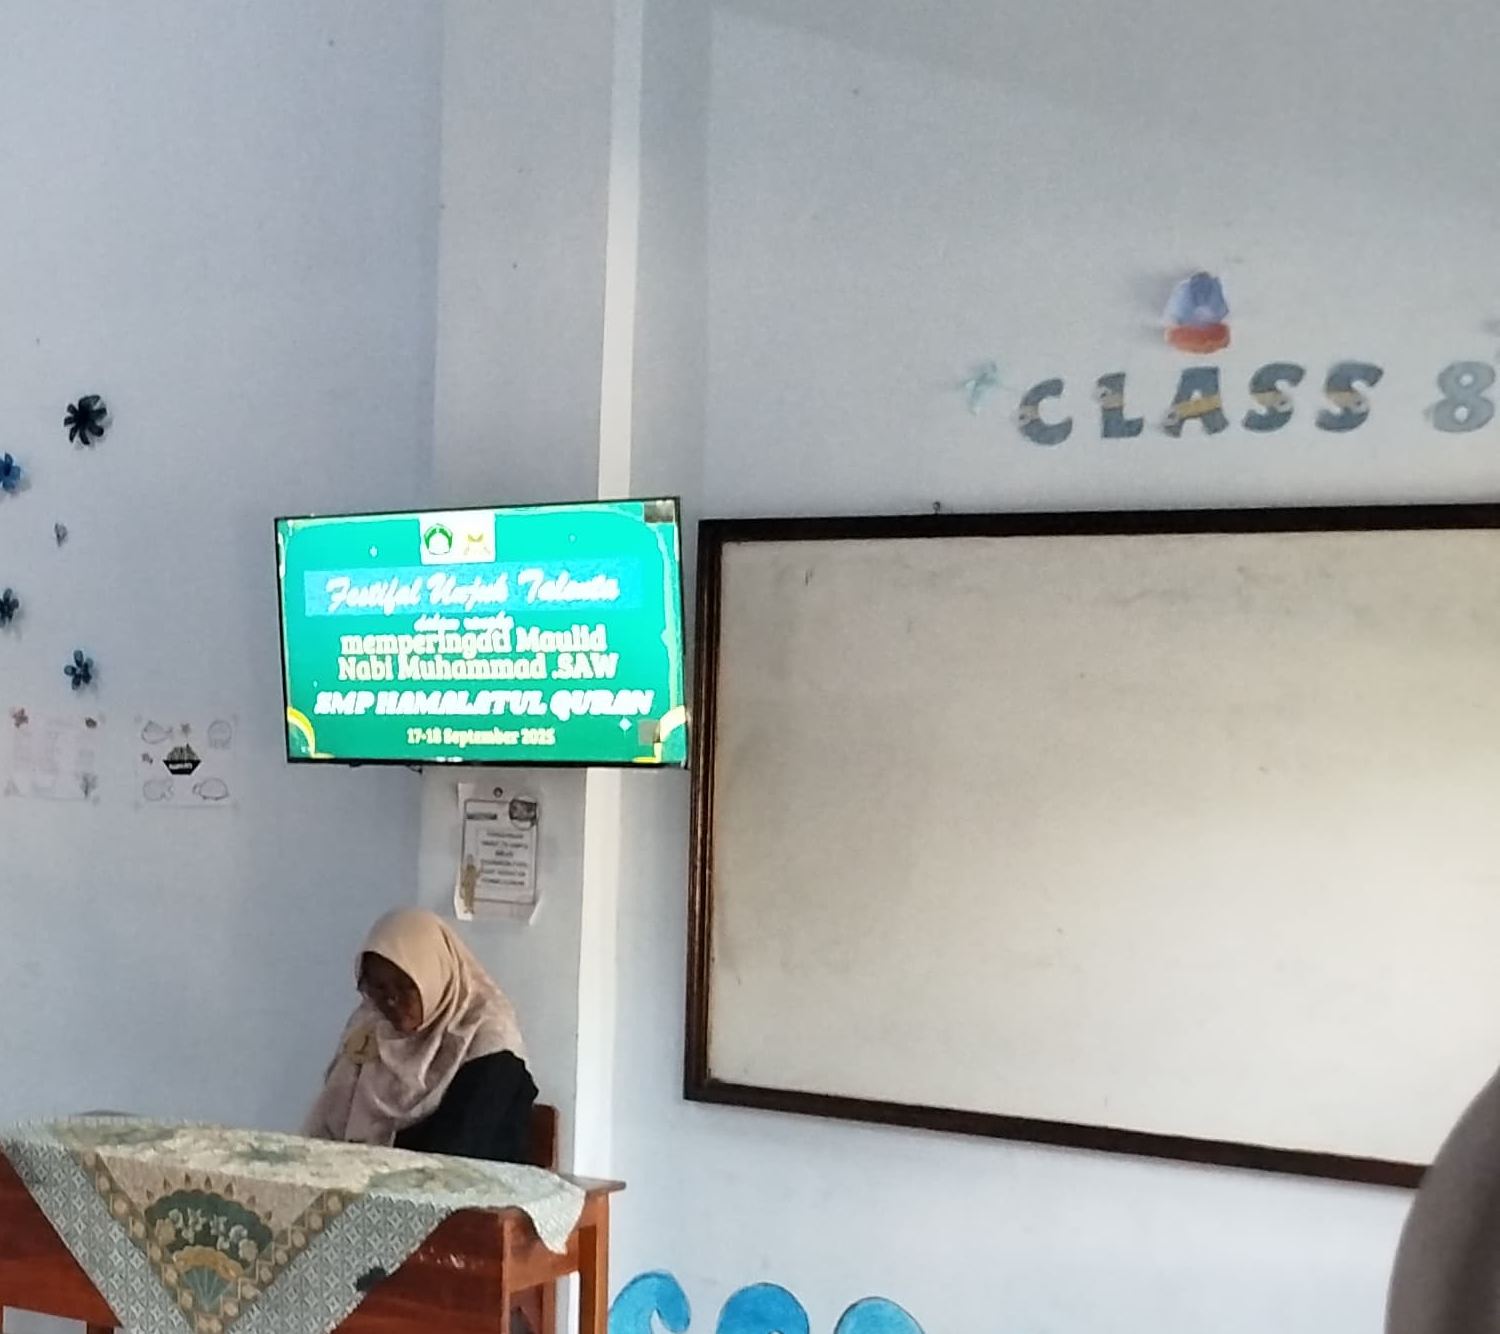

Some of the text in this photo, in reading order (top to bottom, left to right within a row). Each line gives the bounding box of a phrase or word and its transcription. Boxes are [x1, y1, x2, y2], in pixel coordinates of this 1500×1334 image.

[1017, 361, 1497, 446] CLASS 8
[515, 624, 607, 652] Maulid
[338, 651, 619, 681] Nabi Muhammad SAW
[314, 690, 375, 715] SMP
[443, 727, 519, 748] September
